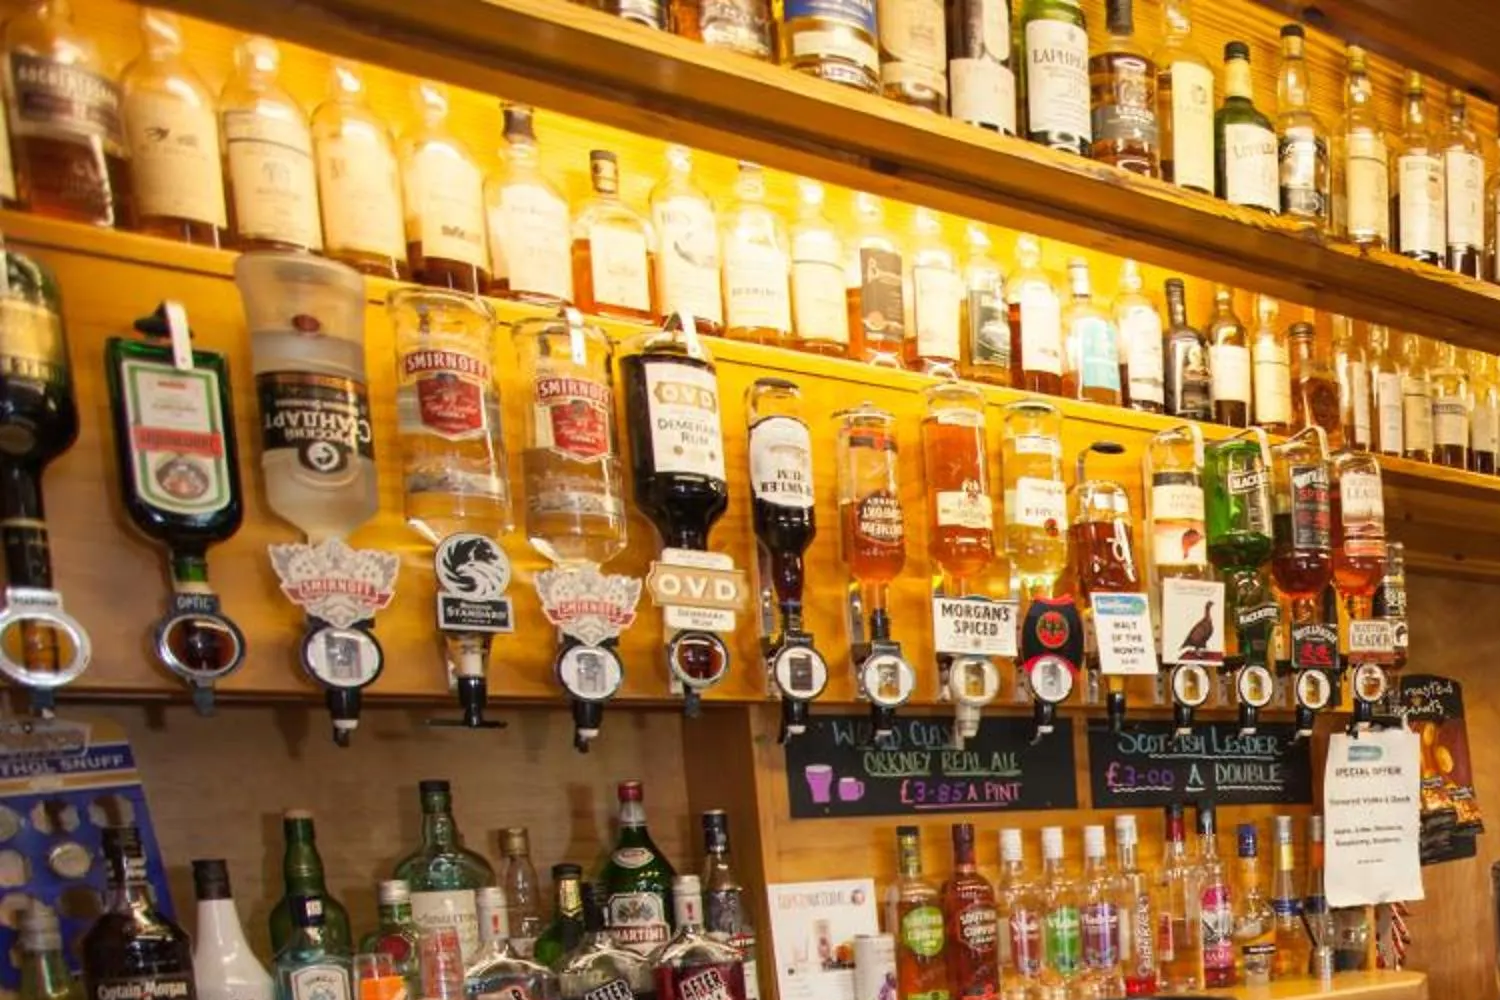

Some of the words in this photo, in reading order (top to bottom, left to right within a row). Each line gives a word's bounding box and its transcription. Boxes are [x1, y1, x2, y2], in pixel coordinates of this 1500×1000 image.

[940, 601, 1011, 622] MORGAN'S
[953, 620, 999, 637] SPICED
[60, 753, 124, 771] SNUFF
[863, 751, 932, 774] ORKNEY
[941, 751, 982, 773] REAL
[990, 750, 1021, 771] ALE
[1188, 763, 1205, 785] A
[1214, 762, 1285, 785] DOUBLE
[1335, 767, 1371, 778] SPECIAL
[966, 785, 979, 801] A
[985, 782, 1023, 801] PINT
[143, 980, 188, 998] Morgan
[681, 968, 725, 1000] AFTER
